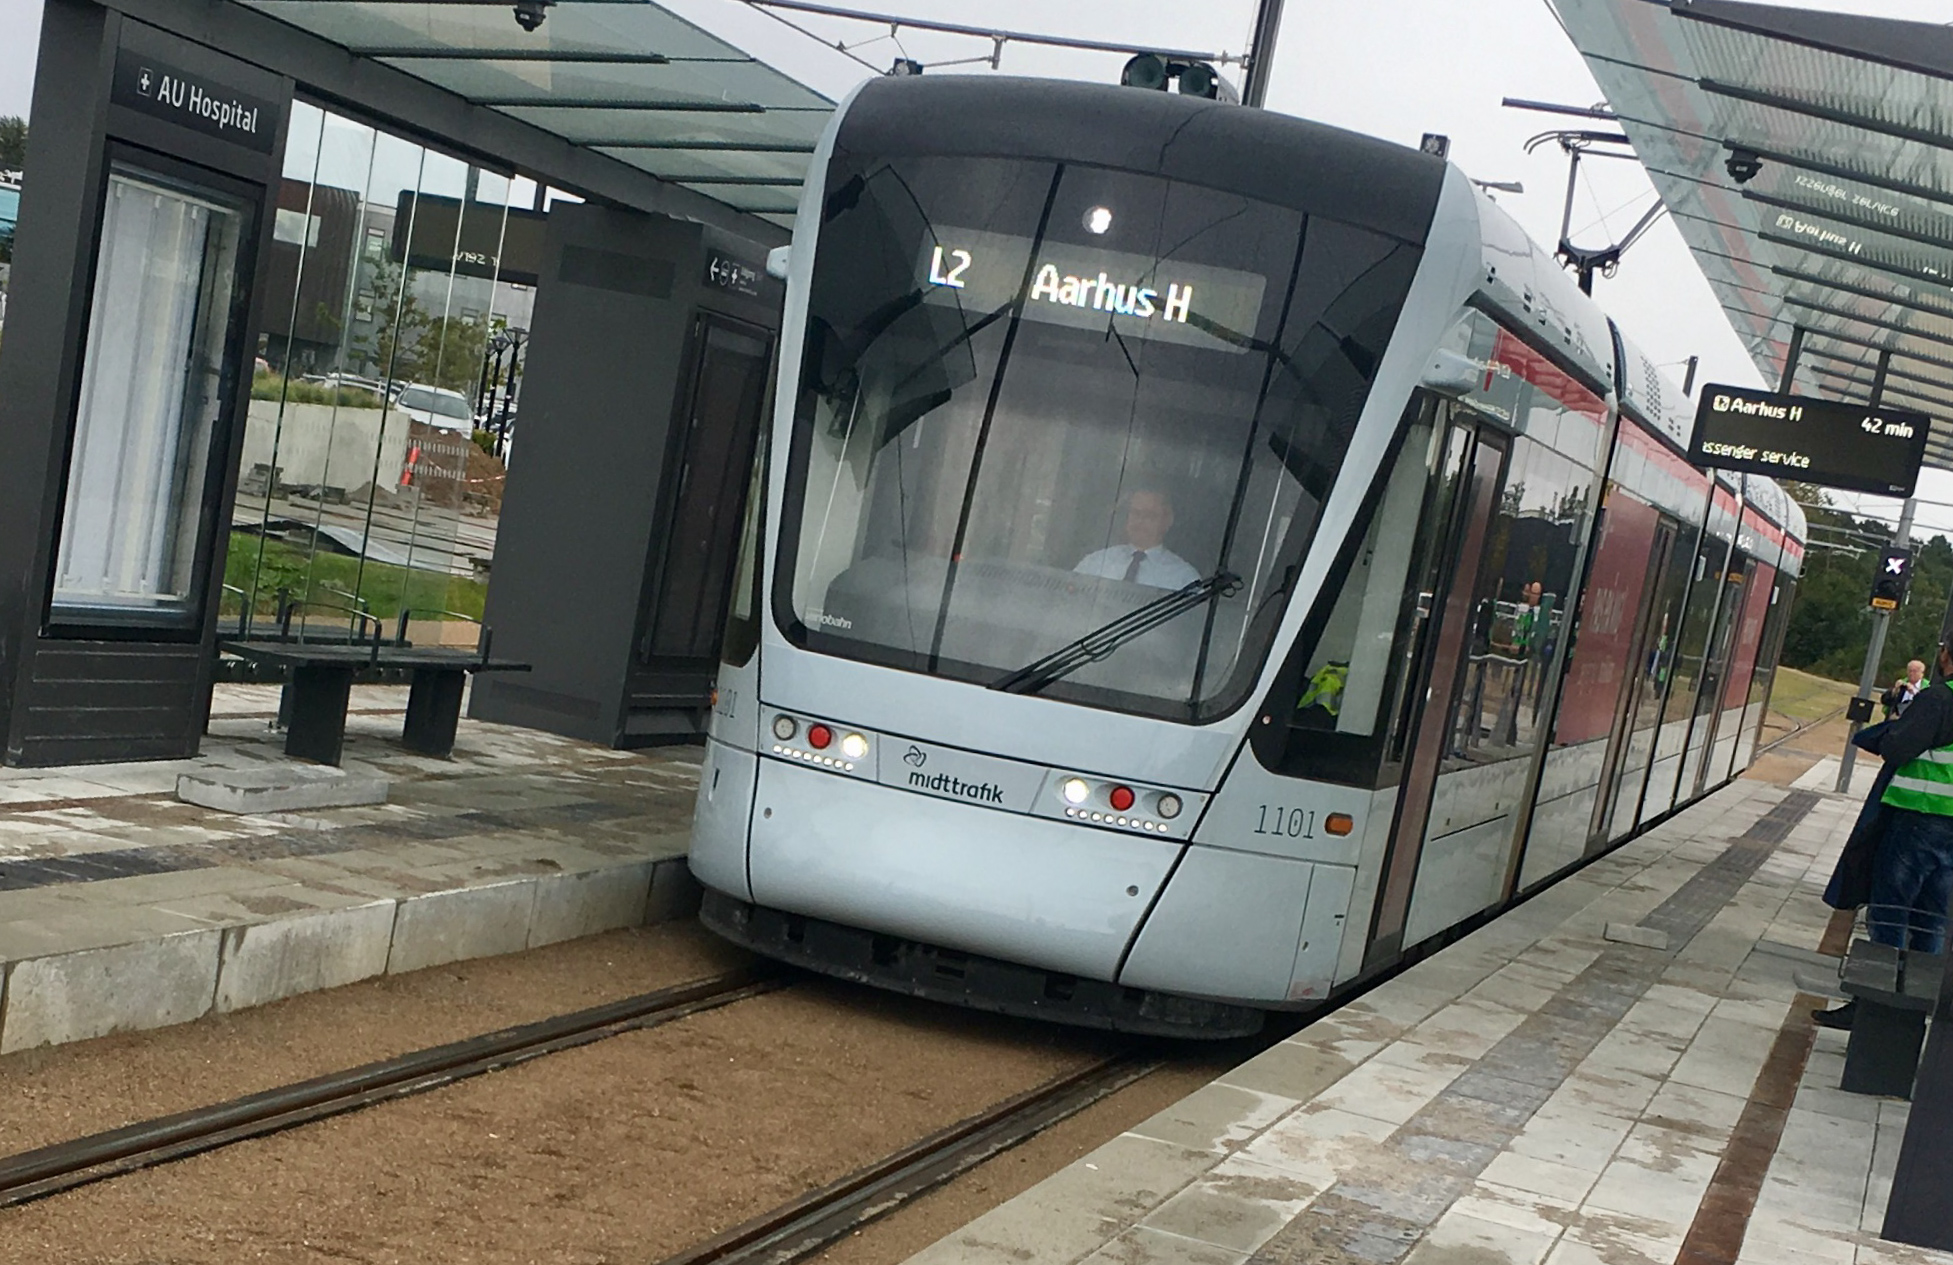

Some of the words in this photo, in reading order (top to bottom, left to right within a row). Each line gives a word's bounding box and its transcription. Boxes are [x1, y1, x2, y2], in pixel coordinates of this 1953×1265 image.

[157, 75, 185, 107] AU
[188, 85, 258, 134] Hospital
[928, 246, 972, 288] L2
[1030, 263, 1158, 318] Aarhus
[1163, 283, 1193, 323] H
[1730, 397, 1787, 419] Aarhus
[1789, 405, 1803, 421] H
[1861, 416, 1883, 434] 42
[1884, 421, 1914, 439] min
[1760, 450, 1810, 469] service
[908, 771, 1004, 803] midttrafik
[1254, 804, 1315, 839] 1101
